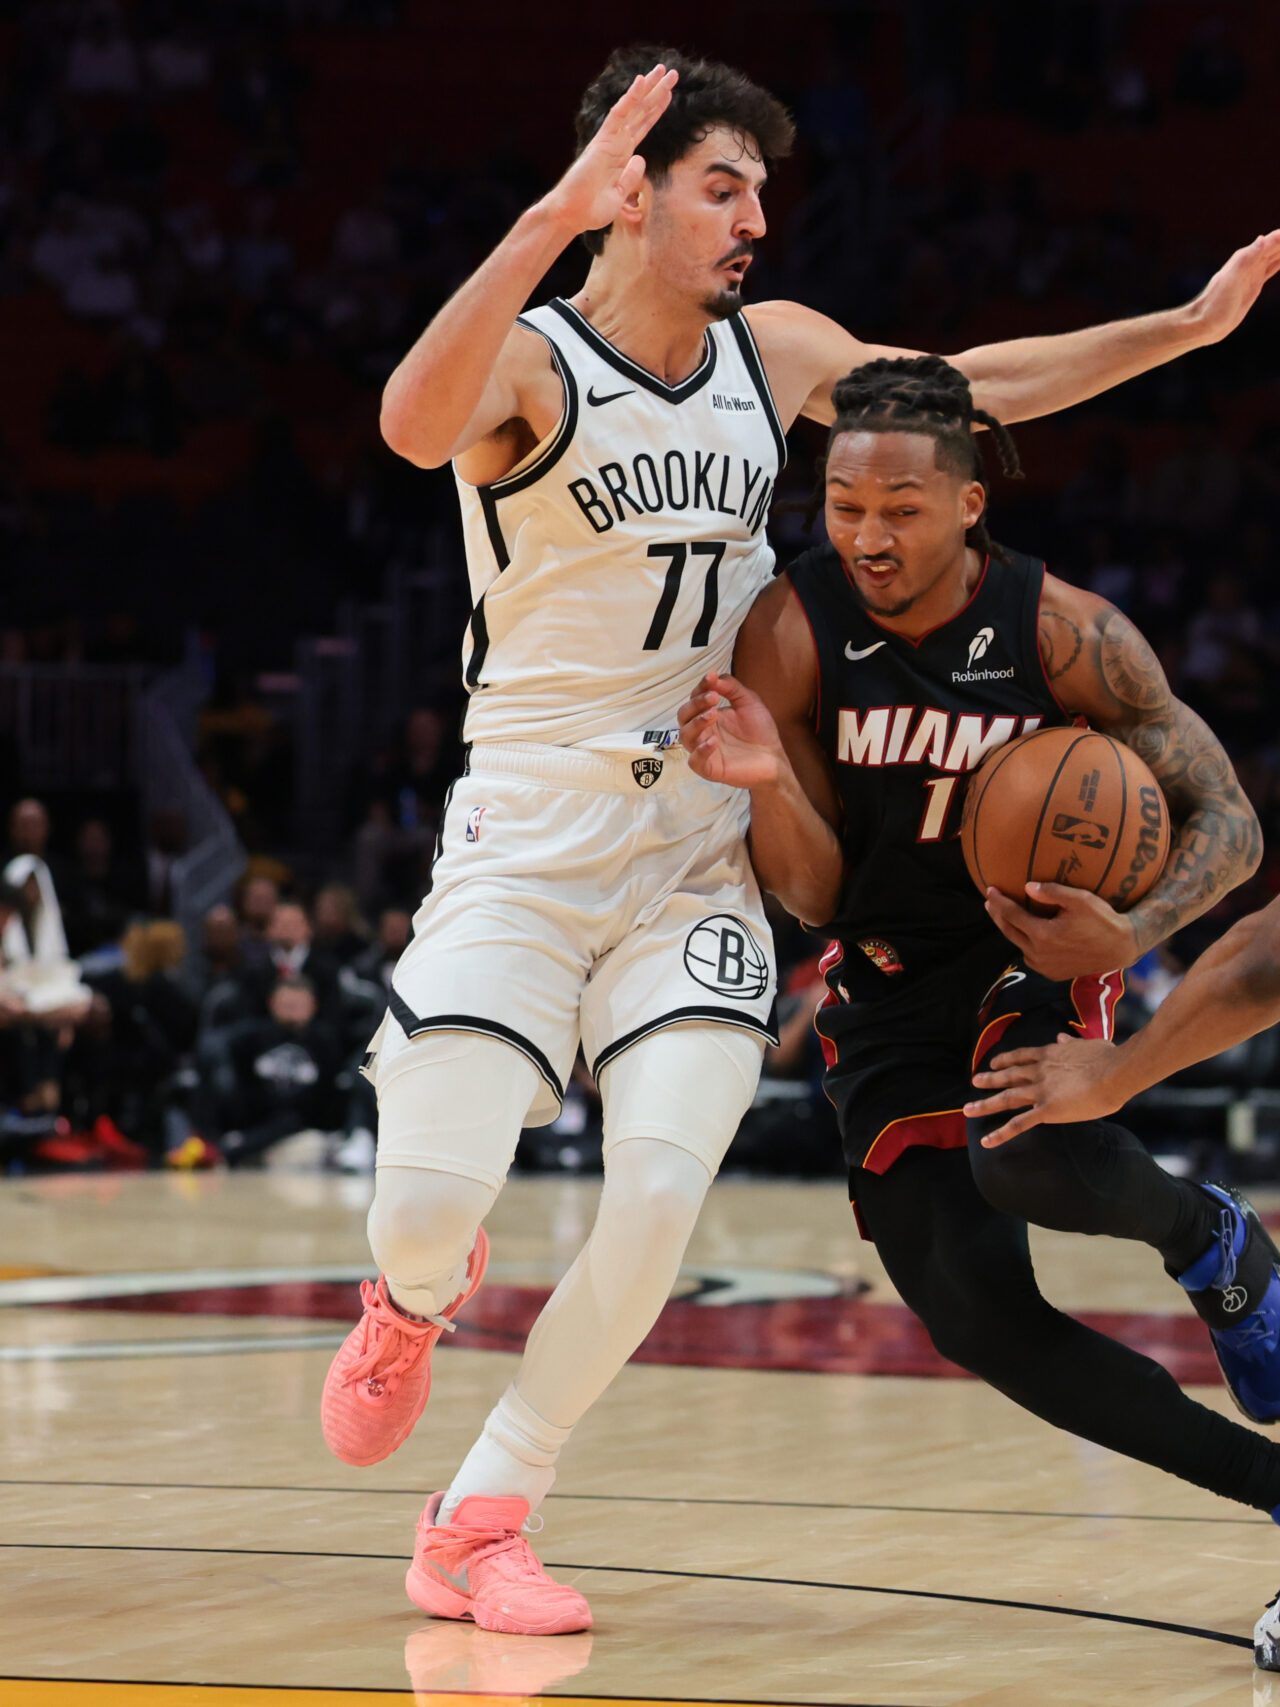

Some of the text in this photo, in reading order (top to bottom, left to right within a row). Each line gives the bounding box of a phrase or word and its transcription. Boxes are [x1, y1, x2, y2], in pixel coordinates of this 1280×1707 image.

[712, 394, 724, 410] All
[731, 397, 756, 411] Won
[567, 449, 774, 536] BROOKLYN
[642, 542, 726, 650] 77
[951, 666, 1015, 683] Robinhood
[634, 760, 661, 774] NETS
[717, 927, 745, 986] B
